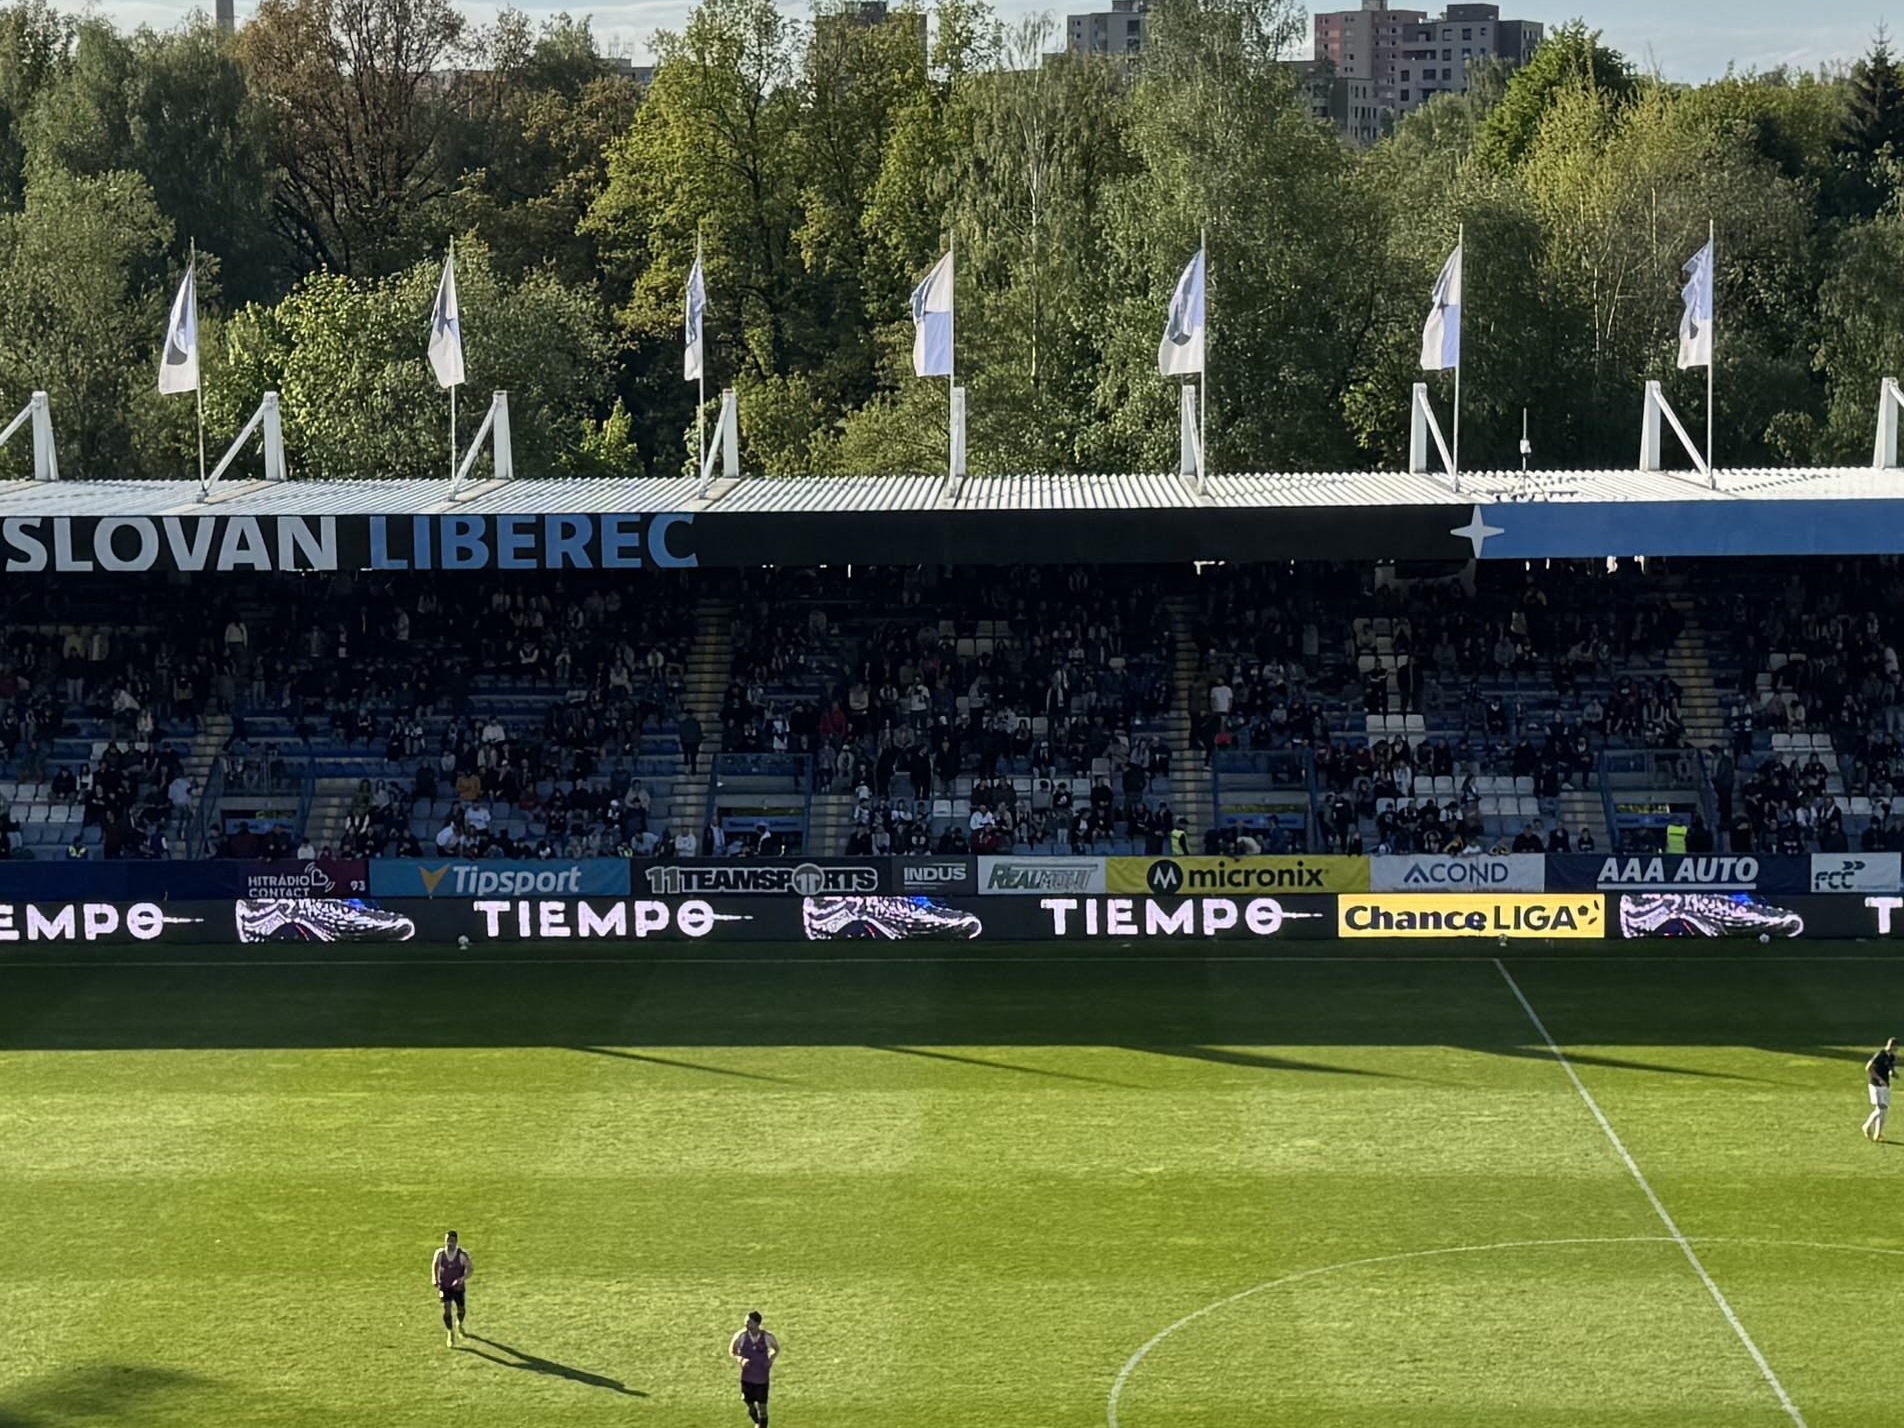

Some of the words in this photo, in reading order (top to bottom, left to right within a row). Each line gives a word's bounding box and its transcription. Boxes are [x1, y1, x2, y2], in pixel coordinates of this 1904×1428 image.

[2, 516, 338, 571] SLOVAN
[369, 514, 698, 570] LIBEREC
[247, 873, 311, 887] HITRÁDIO
[452, 865, 583, 896] Tipsport
[903, 867, 968, 881] INDUS
[1188, 861, 1324, 888] micronix
[1403, 862, 1509, 884] ACOND
[1598, 858, 1666, 882] AAA
[1672, 857, 1759, 882] AUTO
[1814, 871, 1856, 890] FCC
[248, 887, 311, 898] CONTACT
[473, 900, 715, 938] TIEMPO
[1040, 898, 1283, 936] TIEMPO
[1344, 905, 1487, 931] Chance
[1493, 905, 1579, 931] LIGA
